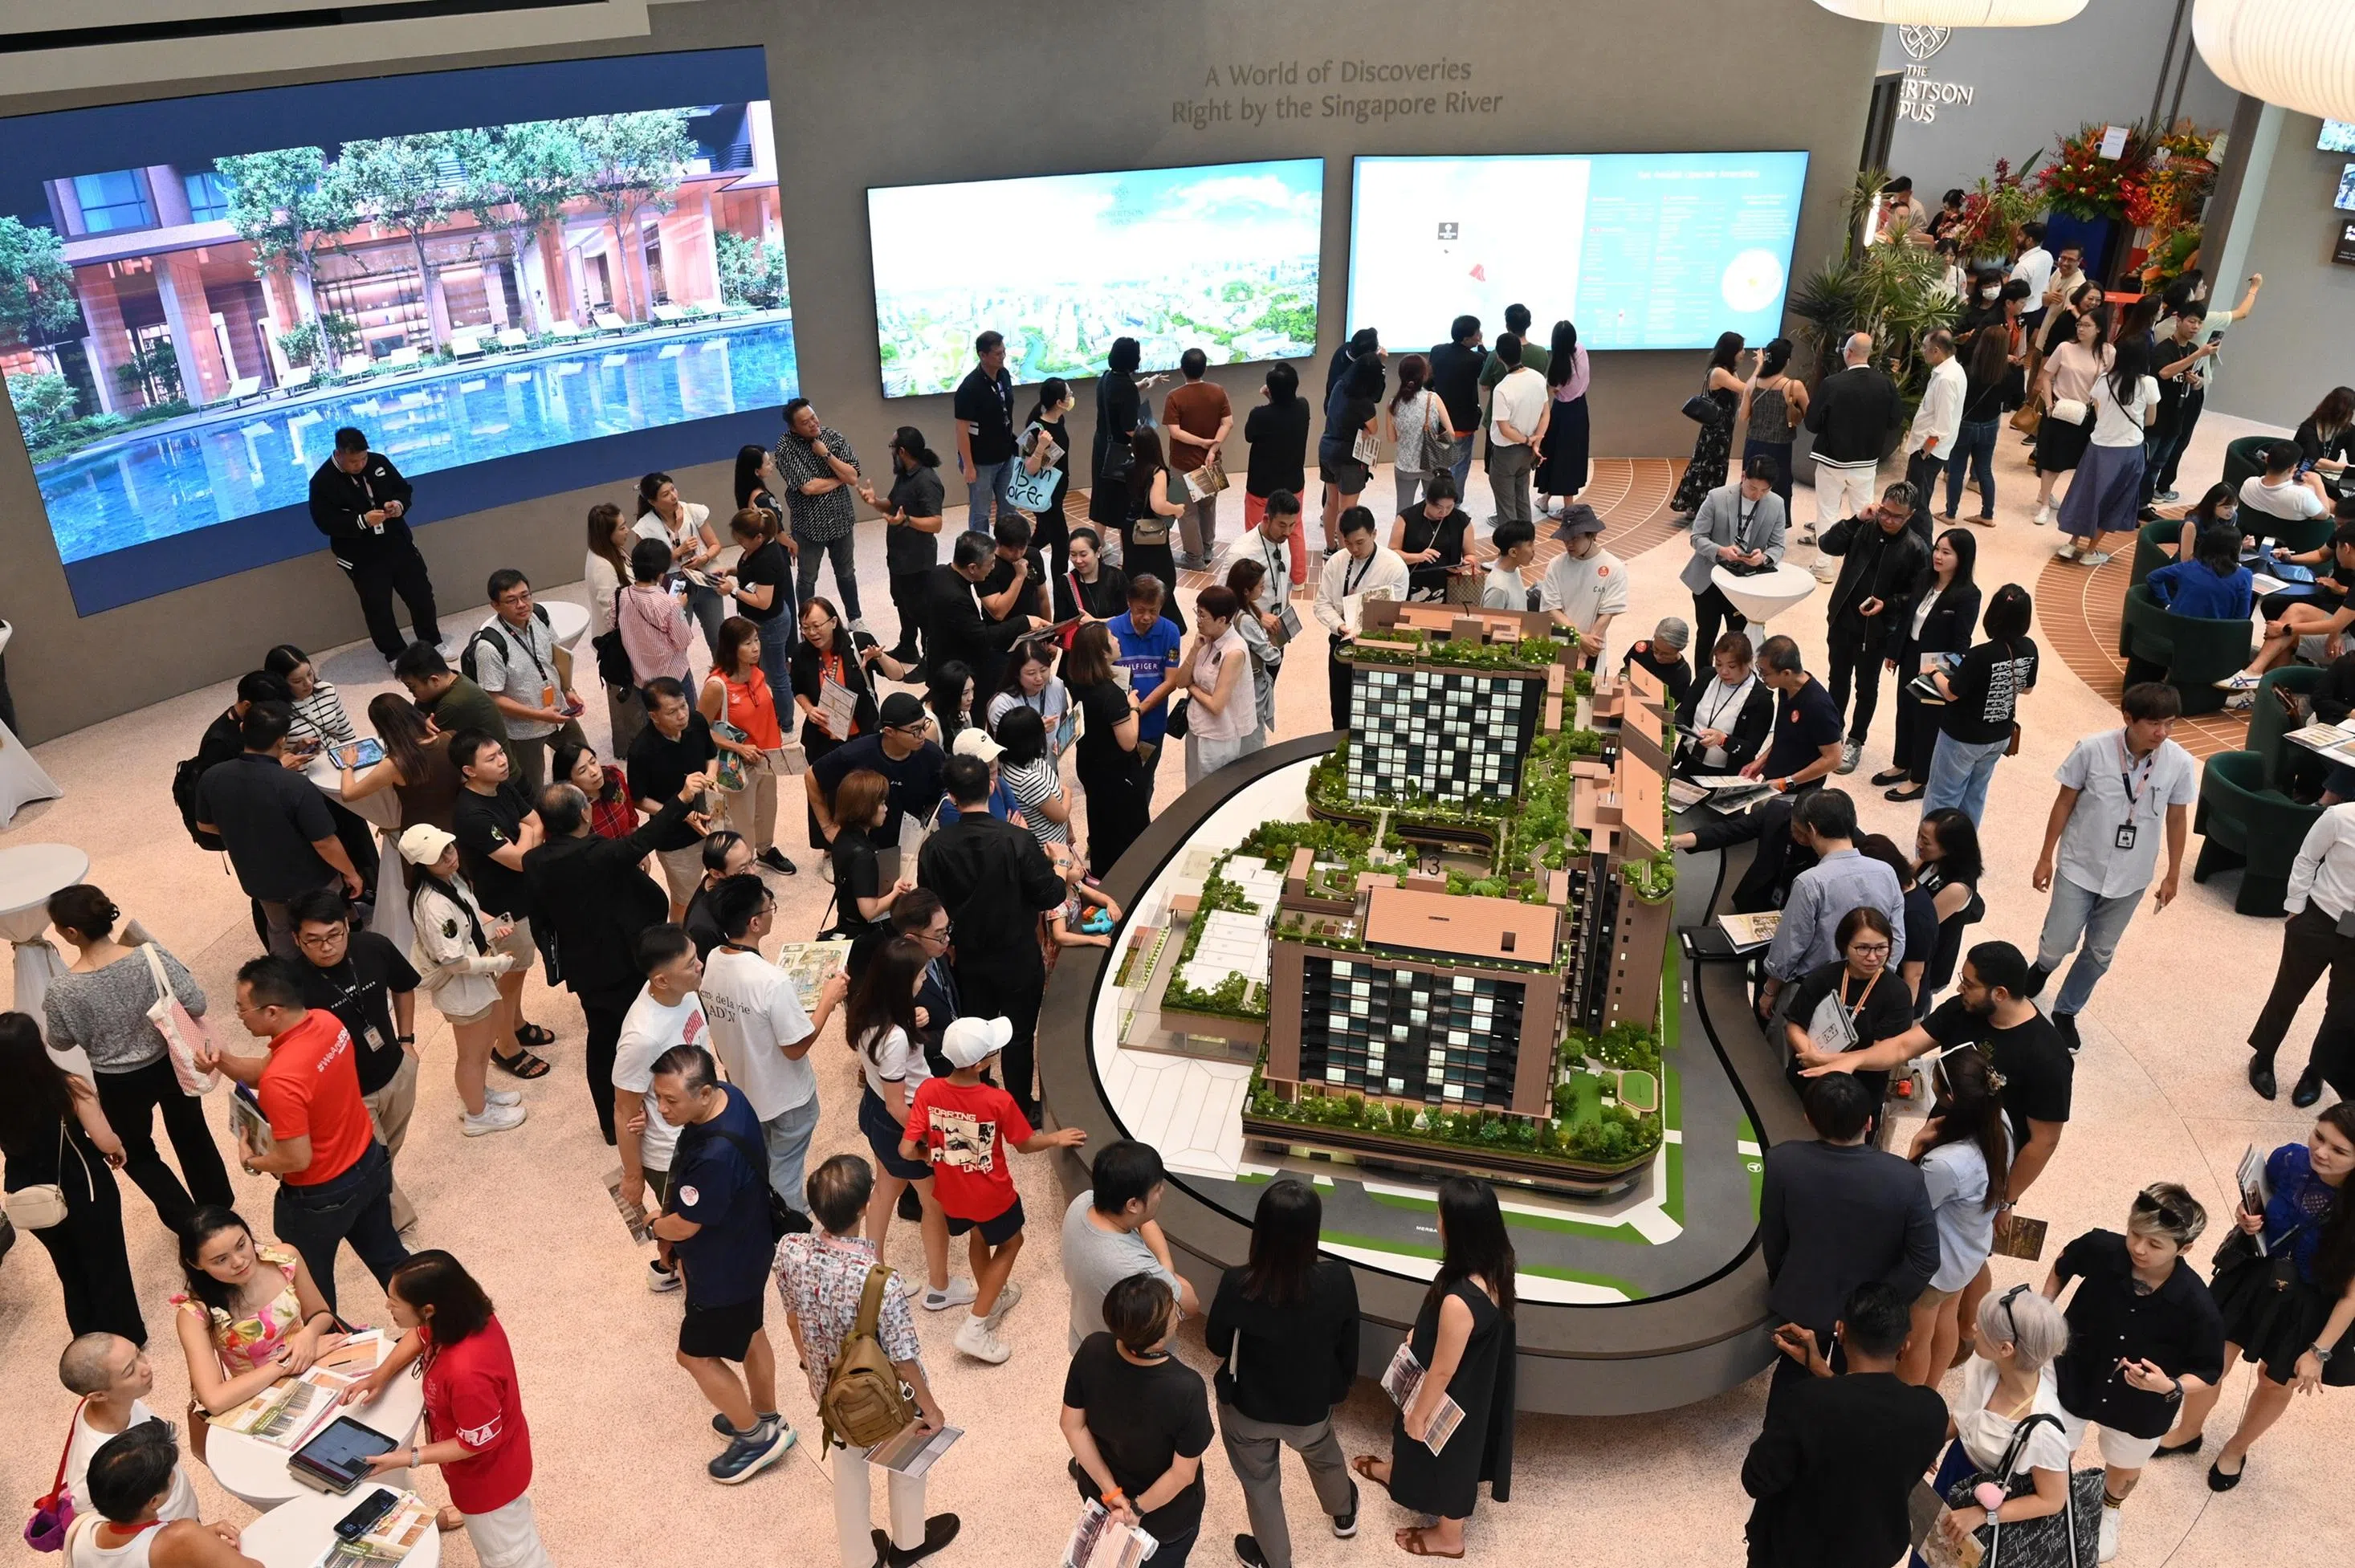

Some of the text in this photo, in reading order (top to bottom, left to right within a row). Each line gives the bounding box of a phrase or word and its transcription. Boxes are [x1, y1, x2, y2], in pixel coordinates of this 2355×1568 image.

[1204, 57, 1472, 88] A World of Discoveries
[1905, 64, 1929, 77] THE
[1172, 90, 1503, 131] Right by the Singapore River
[1122, 662, 1158, 670] LFIGER
[1416, 856, 1440, 875] 13
[927, 1106, 977, 1122] SOARING
